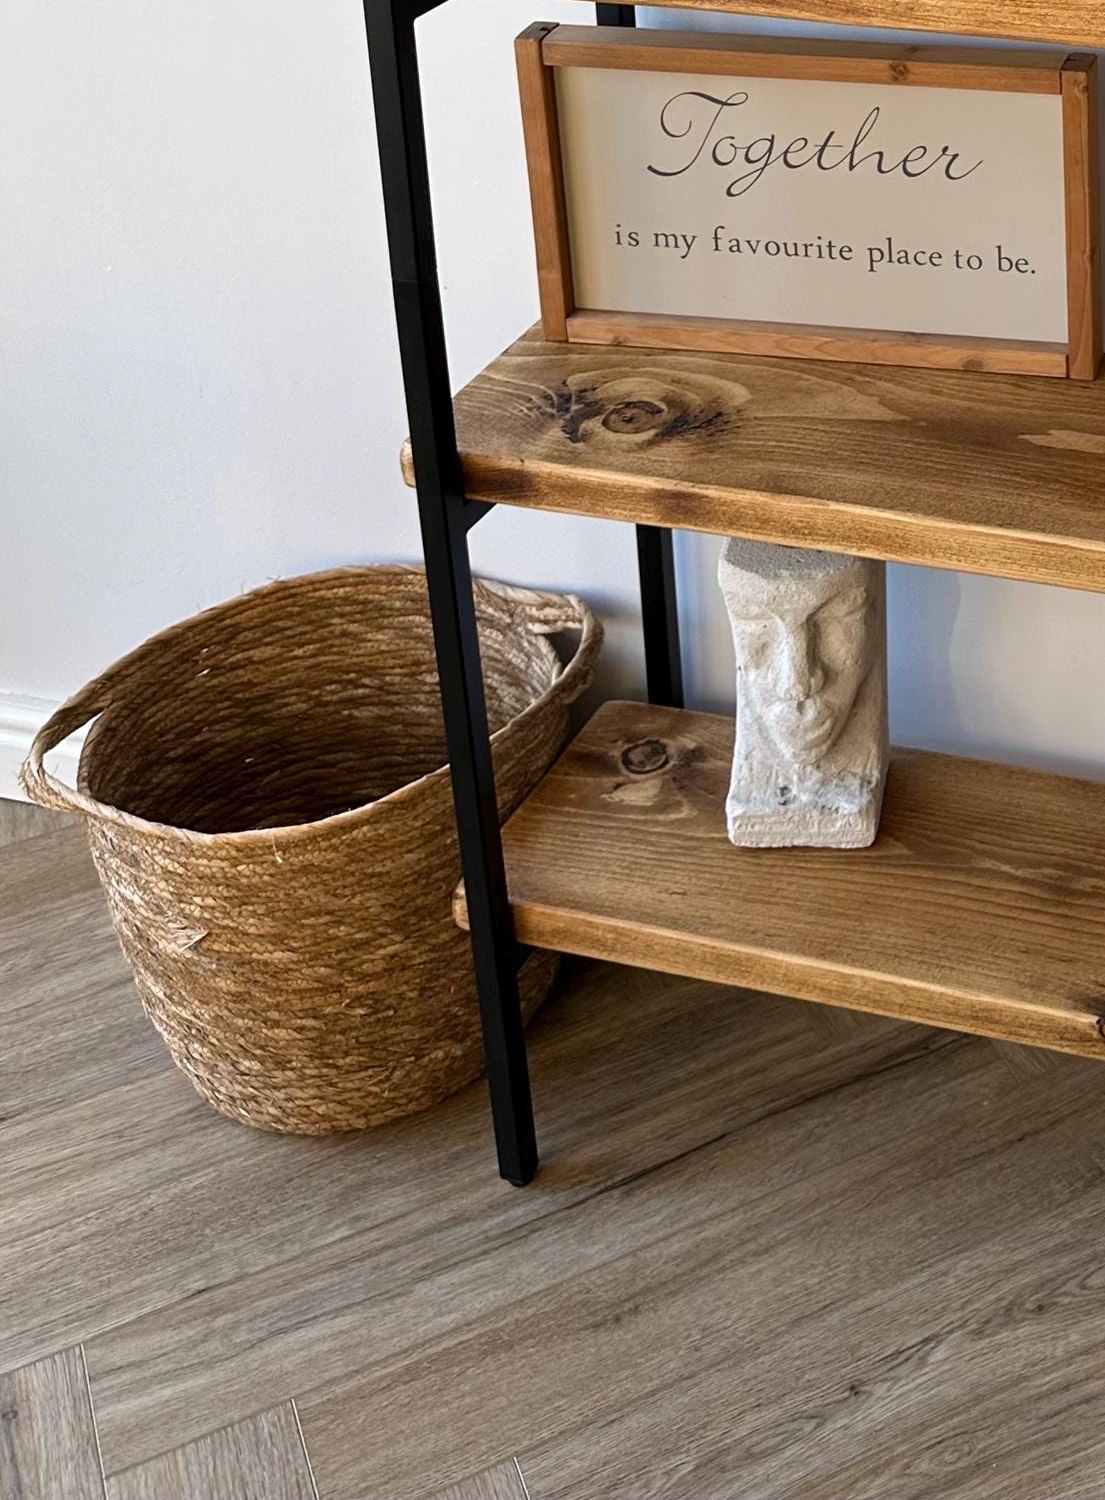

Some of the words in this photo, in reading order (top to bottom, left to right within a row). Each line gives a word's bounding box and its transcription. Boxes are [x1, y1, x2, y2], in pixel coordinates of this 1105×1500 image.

[646, 91, 984, 198] Together
[614, 223, 640, 248] is
[652, 231, 699, 260] my
[711, 224, 854, 262] favourite
[866, 236, 943, 273] place
[953, 249, 984, 272] to
[995, 244, 1038, 275] be.
